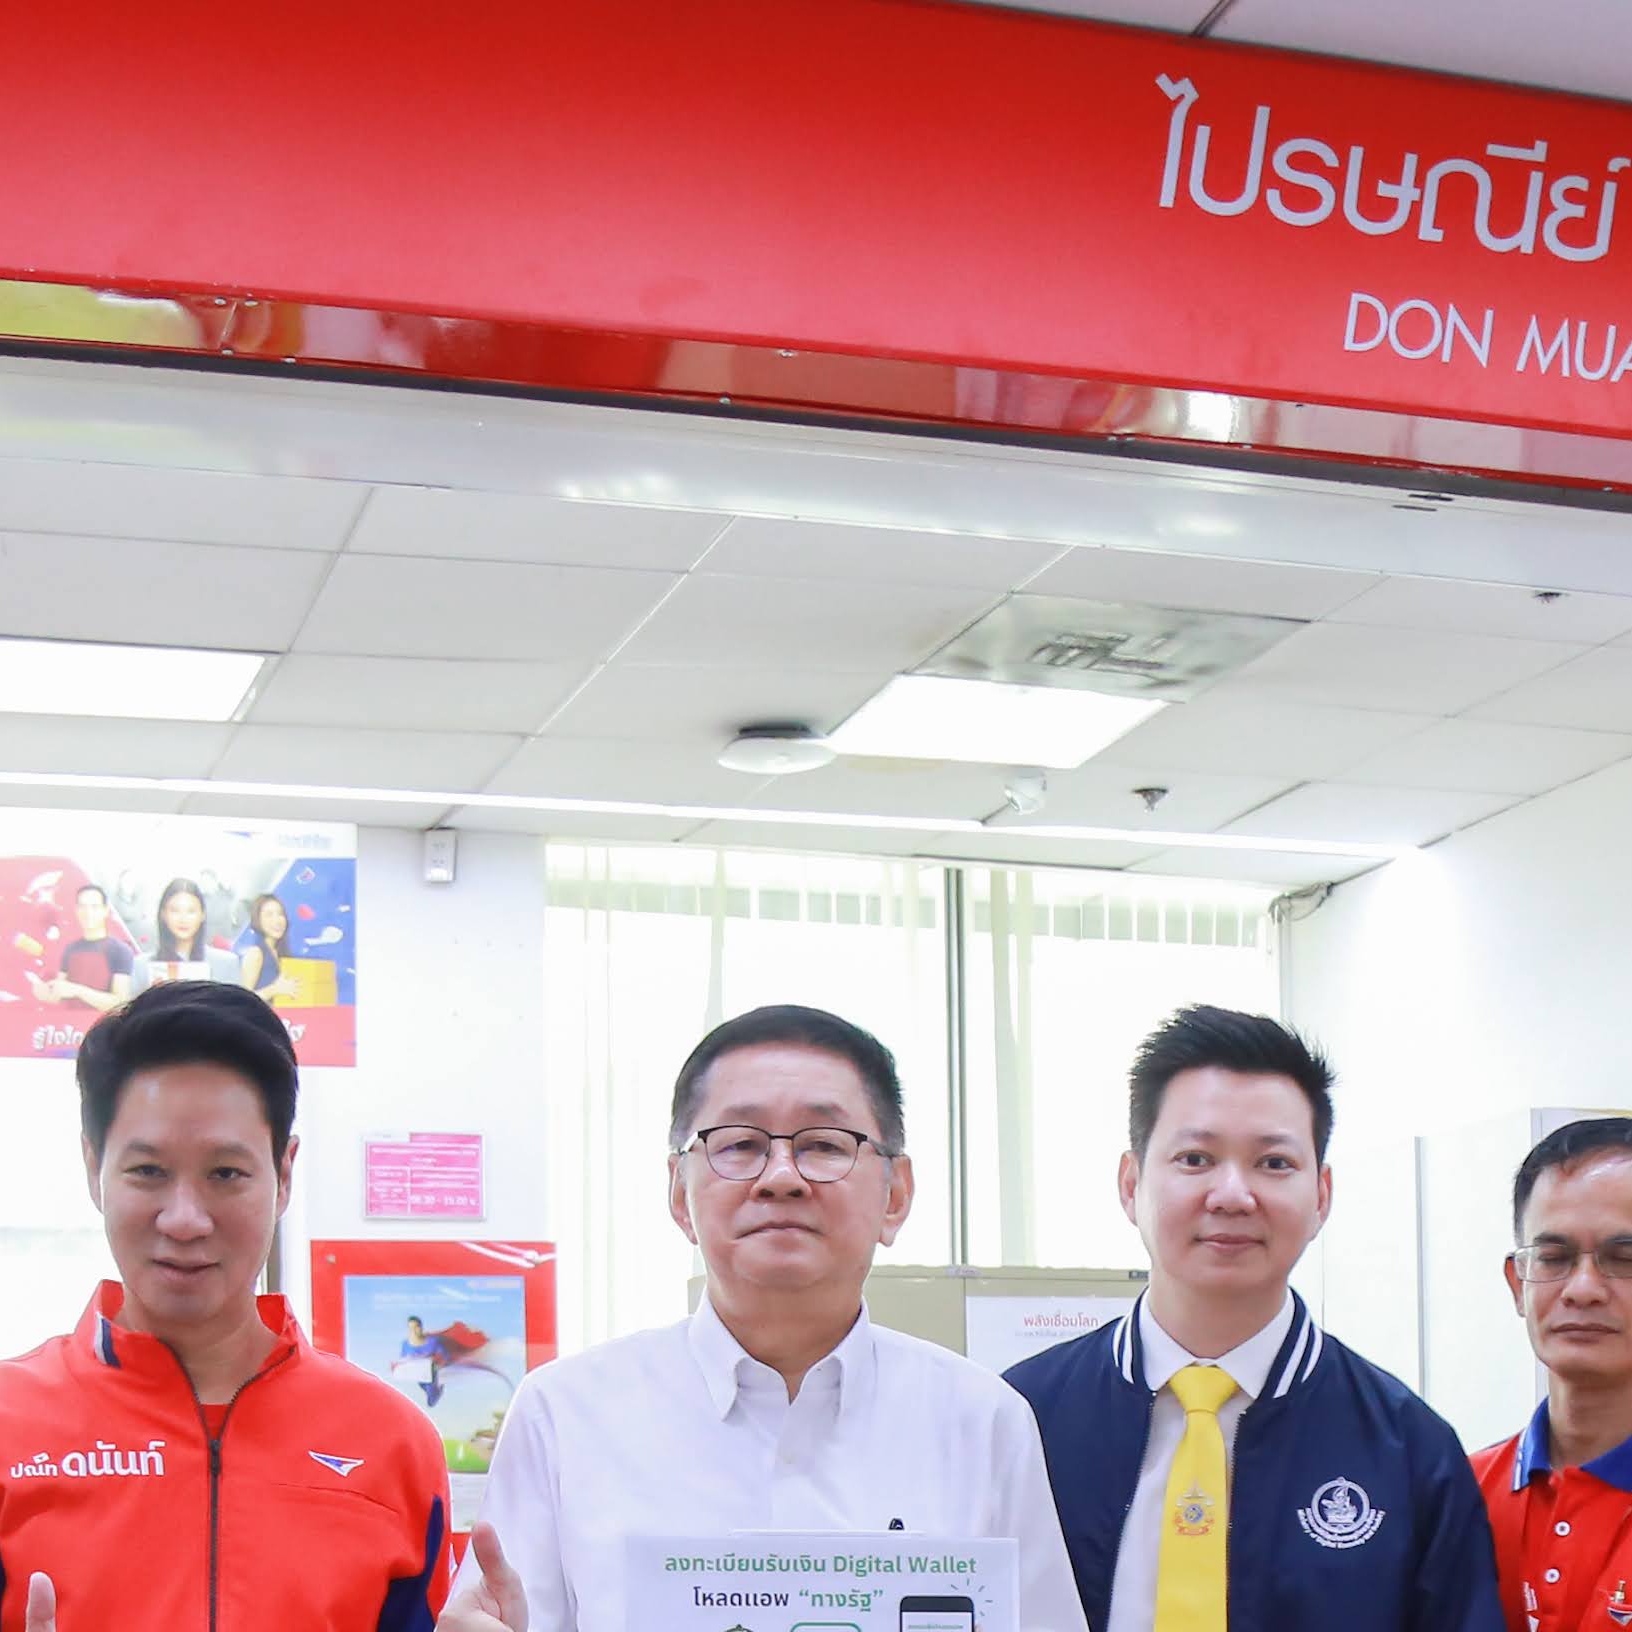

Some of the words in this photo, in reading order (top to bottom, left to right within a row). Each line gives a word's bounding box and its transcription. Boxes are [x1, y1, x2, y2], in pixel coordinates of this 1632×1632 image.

[1156, 73, 1631, 262] ไปรษณีย์
[1343, 292, 1494, 368] DON
[62, 1440, 165, 1477] ดนันท์
[665, 1552, 827, 1577] ลงทะเบียนรับเงิน
[833, 1554, 901, 1577] Digital
[908, 1554, 977, 1574] Wallet
[693, 1585, 789, 1609] โหลดแอพ
[799, 1587, 884, 1613] “ทางรัฐ”
